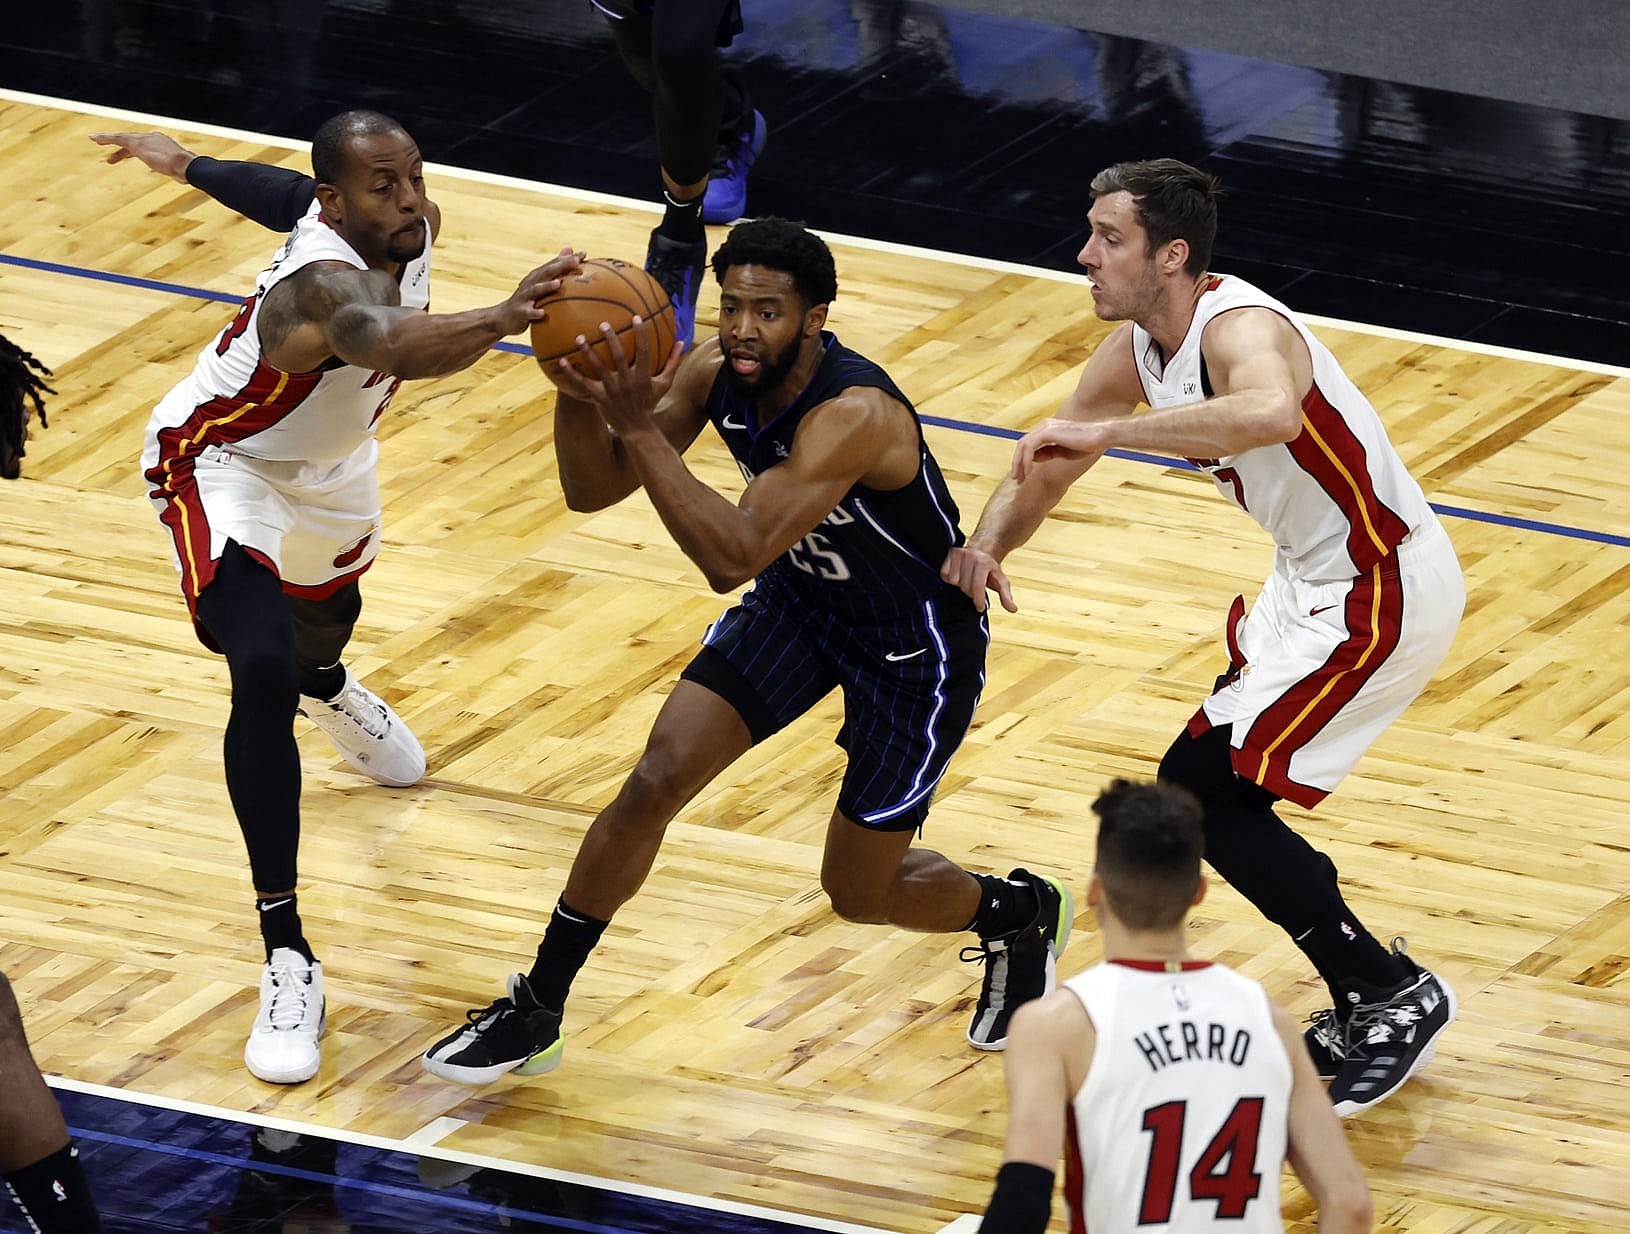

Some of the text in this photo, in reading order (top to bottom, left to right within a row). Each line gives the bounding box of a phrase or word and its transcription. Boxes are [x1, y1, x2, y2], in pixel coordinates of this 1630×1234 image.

[1213, 467, 1249, 512] 7
[788, 532, 852, 581] 25
[1134, 1021, 1251, 1072] HERRO
[1137, 1096, 1265, 1227] 14
